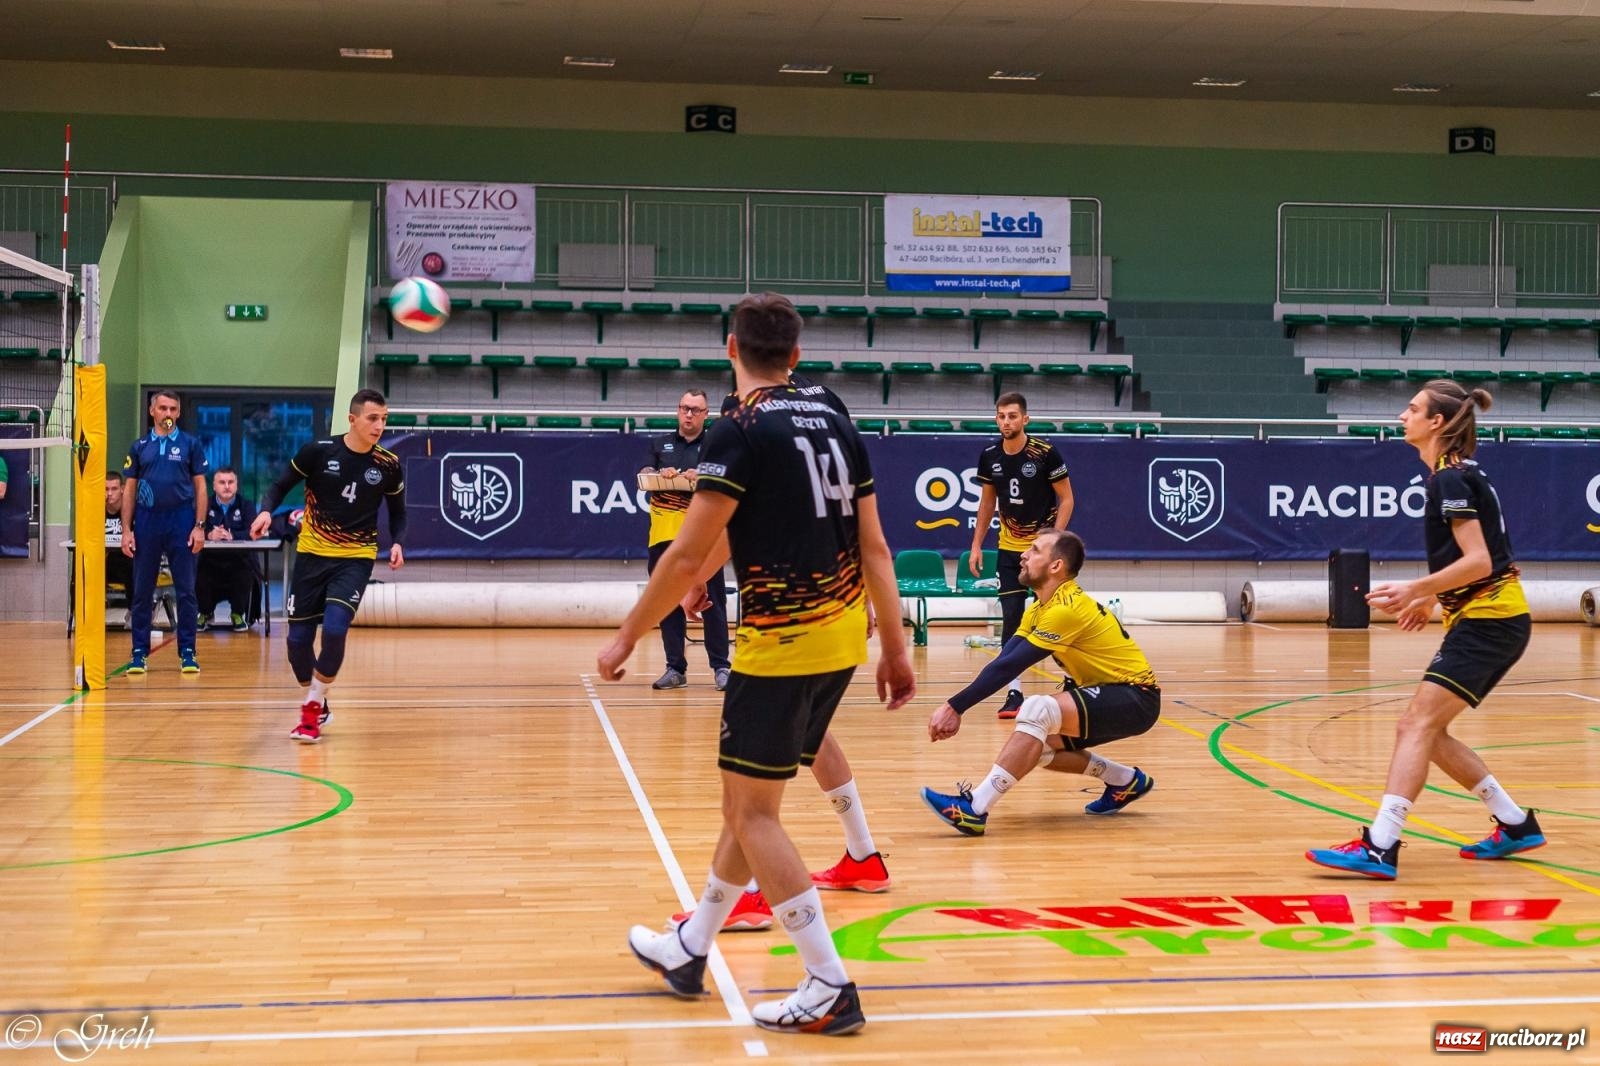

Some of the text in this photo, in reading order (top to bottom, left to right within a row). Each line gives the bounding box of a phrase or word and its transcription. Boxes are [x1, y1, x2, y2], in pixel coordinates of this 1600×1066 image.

[690, 113, 708, 129] C
[717, 114, 733, 129] C
[1455, 136, 1475, 151] D
[1483, 136, 1493, 151] D
[404, 187, 518, 211] MIESZKO
[406, 221, 440, 231] Operator
[912, 207, 1043, 237] instal-tech
[935, 244, 945, 252] 92
[899, 254, 928, 262] 47-400
[1001, 255, 1050, 264] Eichendorffa
[1051, 256, 1057, 264] 2
[935, 277, 1021, 290] www.instal-tech.pl
[793, 436, 856, 518] 14
[341, 481, 357, 503] 4
[1009, 477, 1020, 497] 6
[287, 594, 296, 616] 4
